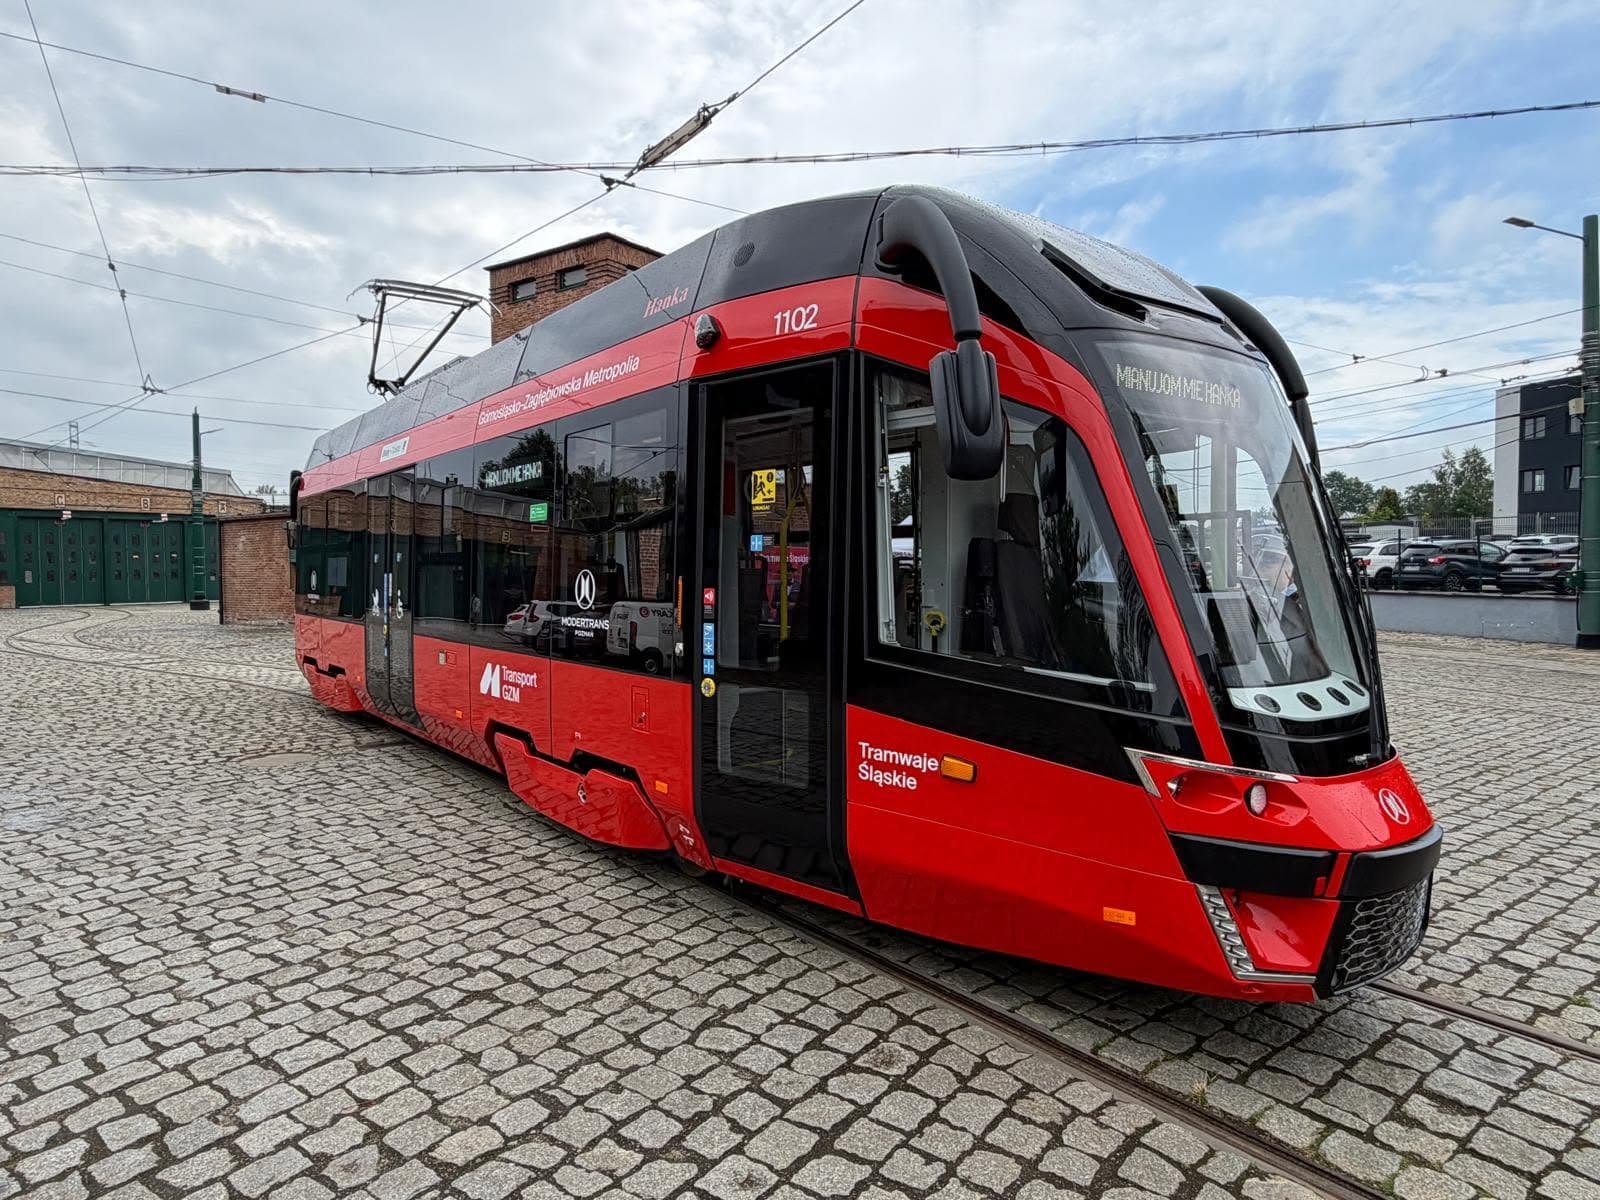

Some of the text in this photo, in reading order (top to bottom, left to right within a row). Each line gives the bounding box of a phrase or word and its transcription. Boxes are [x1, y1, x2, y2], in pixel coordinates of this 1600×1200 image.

[643, 286, 689, 318] Hanka
[773, 304, 819, 336] 1102
[582, 354, 640, 388] Metropolia
[1116, 363, 1241, 408] MIANUJOM MIE HANKA
[561, 616, 610, 630] MODERTRANS
[501, 665, 538, 688] Transport
[502, 684, 520, 704] GZM
[858, 741, 940, 773] Tramwaje
[858, 761, 918, 790] Śląskie
